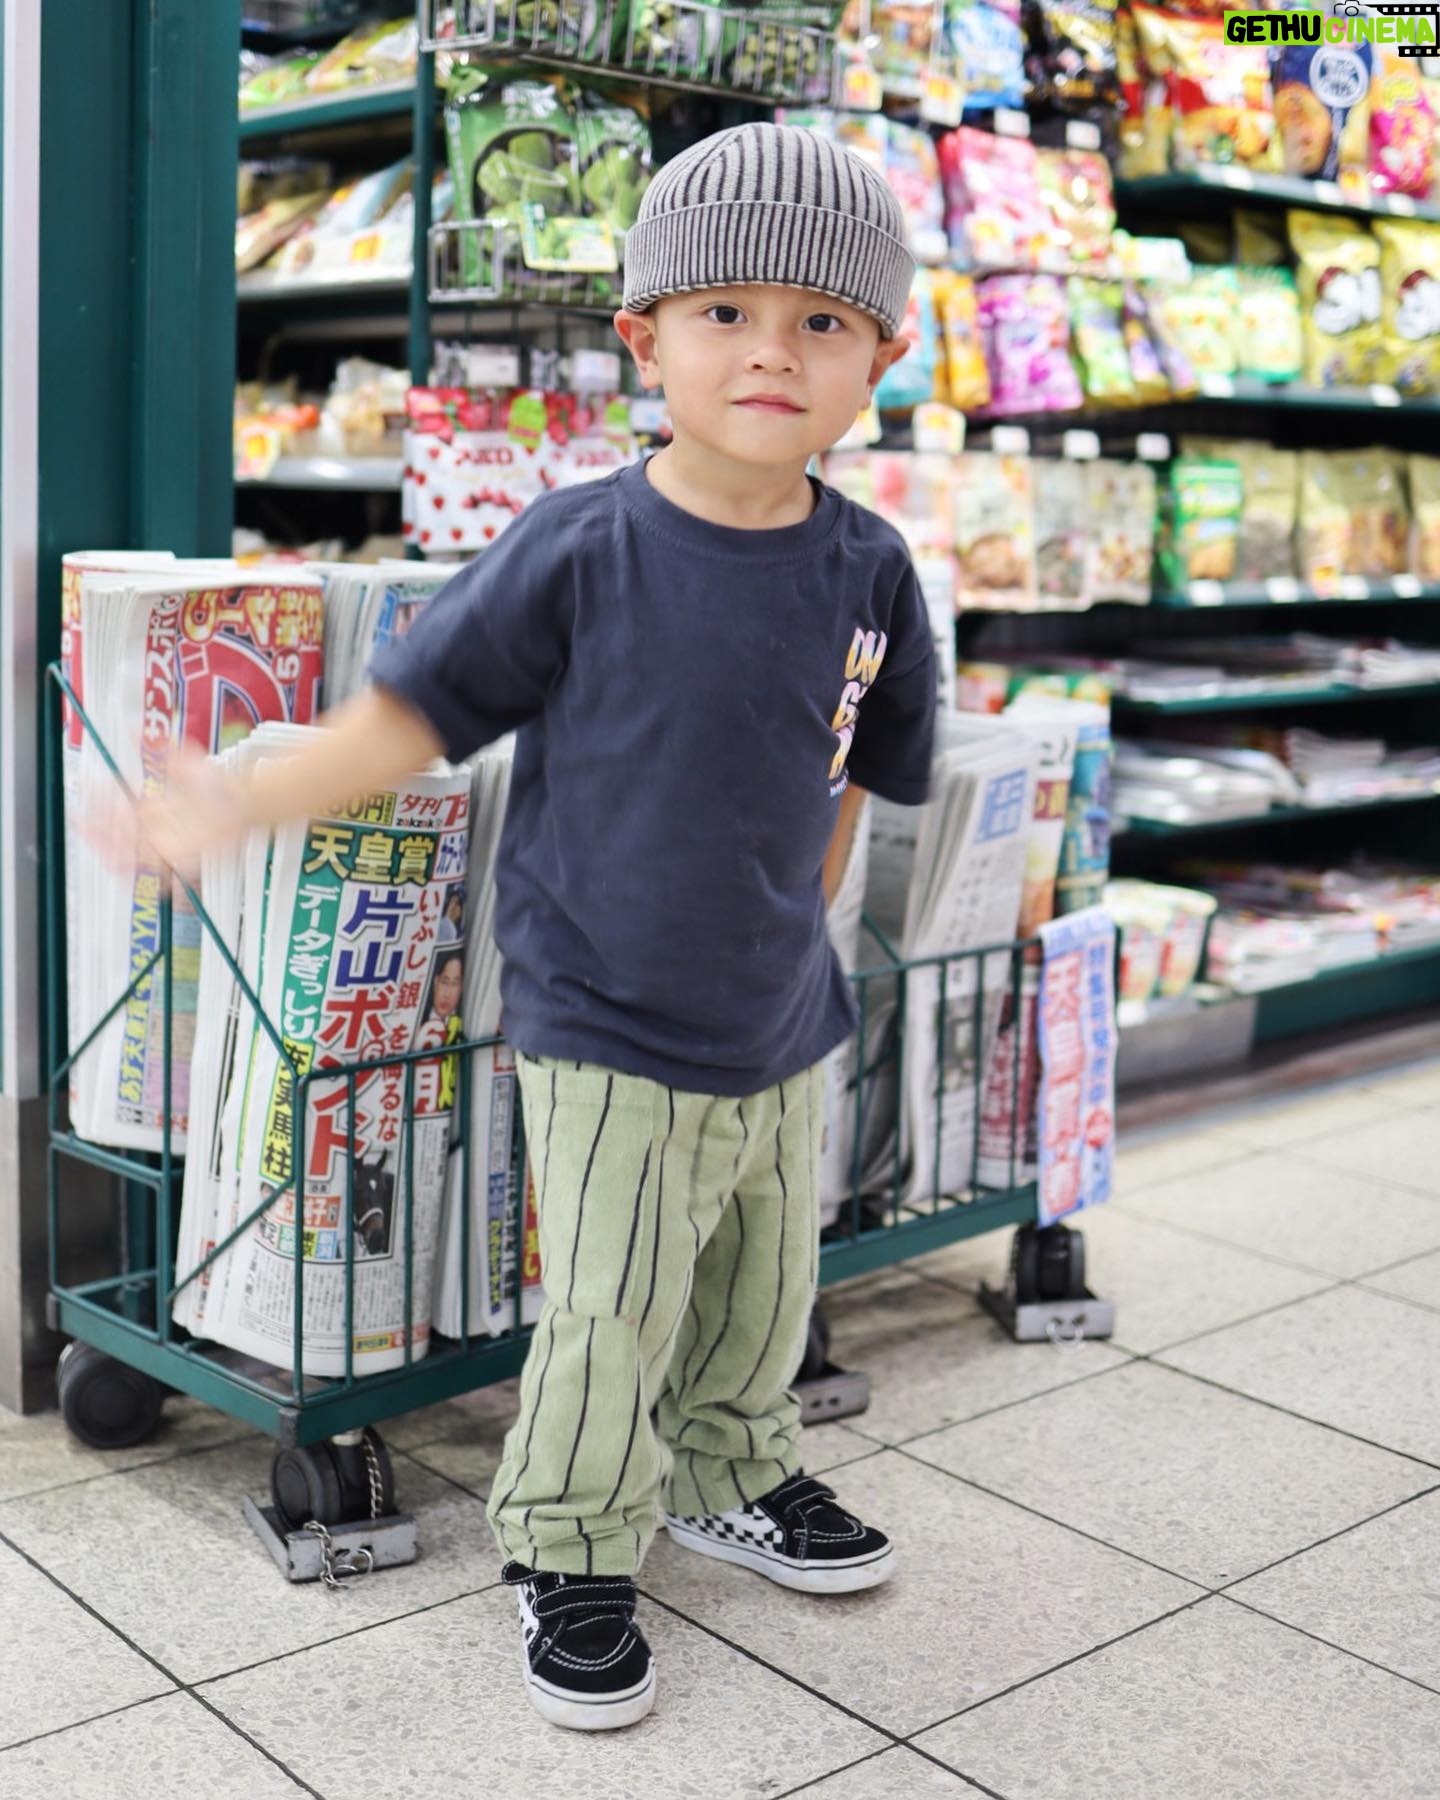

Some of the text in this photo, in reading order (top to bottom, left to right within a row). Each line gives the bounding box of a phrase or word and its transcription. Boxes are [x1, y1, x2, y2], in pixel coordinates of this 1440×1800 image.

[303, 824, 435, 888] 天皇賞
[282, 883, 342, 1039] データぎっしり
